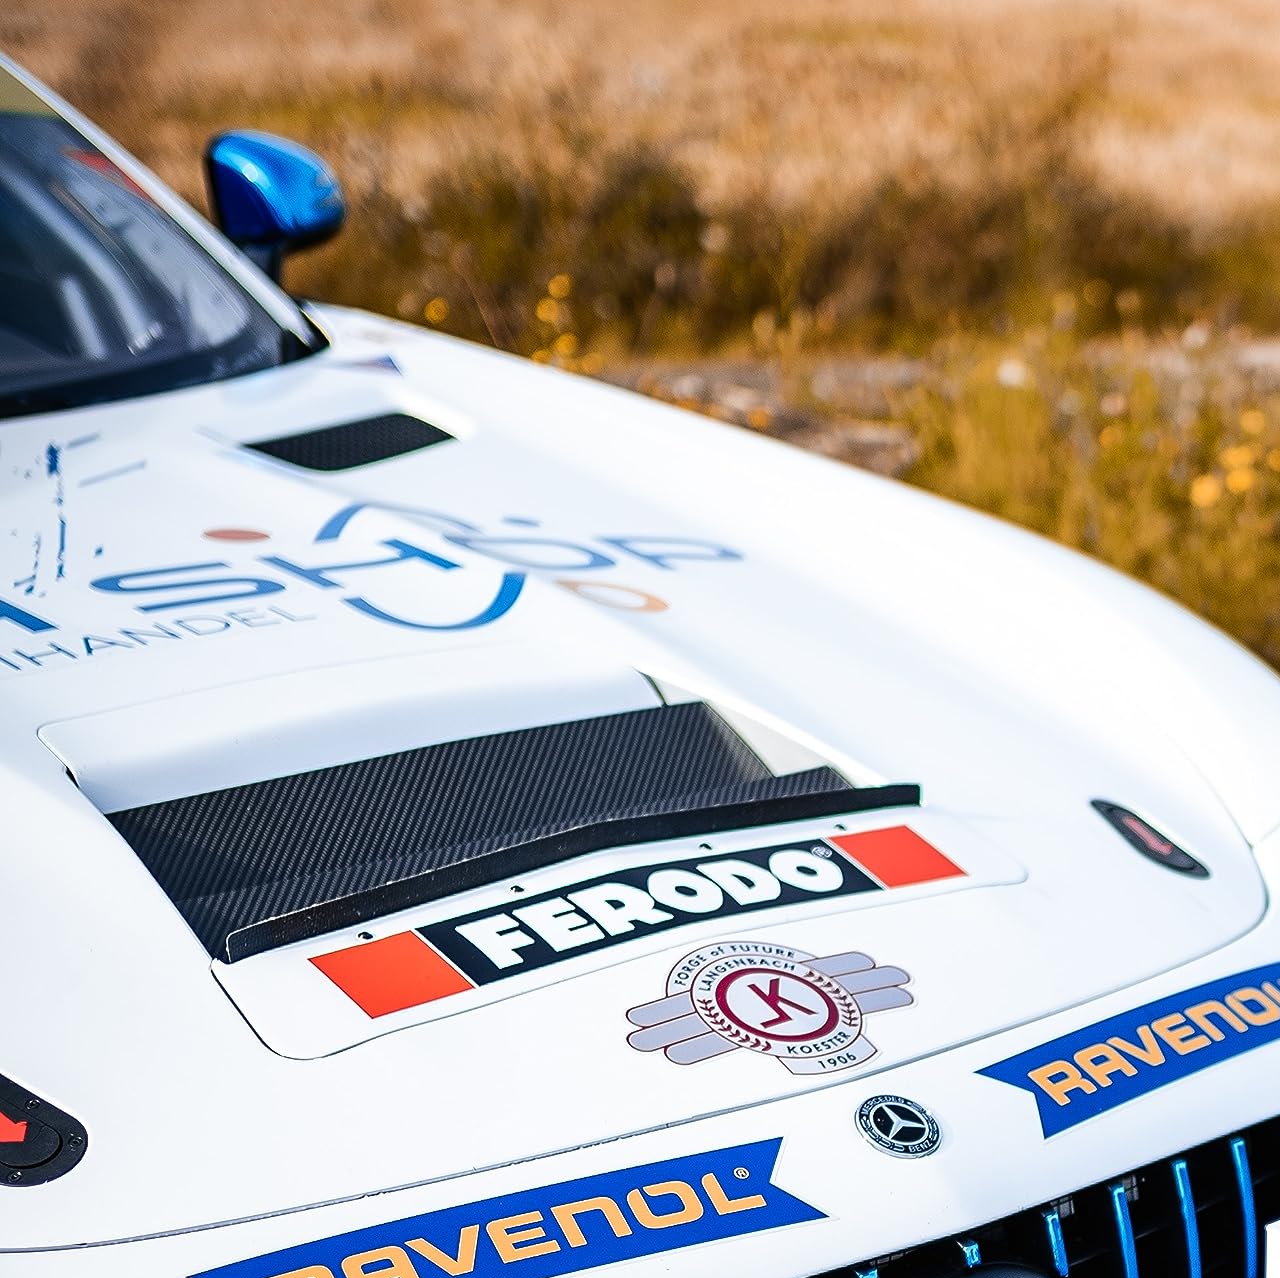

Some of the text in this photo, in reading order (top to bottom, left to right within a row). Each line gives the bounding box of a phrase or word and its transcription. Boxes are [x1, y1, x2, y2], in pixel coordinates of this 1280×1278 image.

[90, 534, 745, 613] SHOP
[673, 954, 707, 986] FORGE
[730, 944, 795, 959] FUTURE
[698, 957, 796, 992] LANGENBACH
[787, 1031, 851, 1055] KOESTER
[818, 1052, 857, 1070] 1906
[908, 1139, 933, 1153] BENZ
